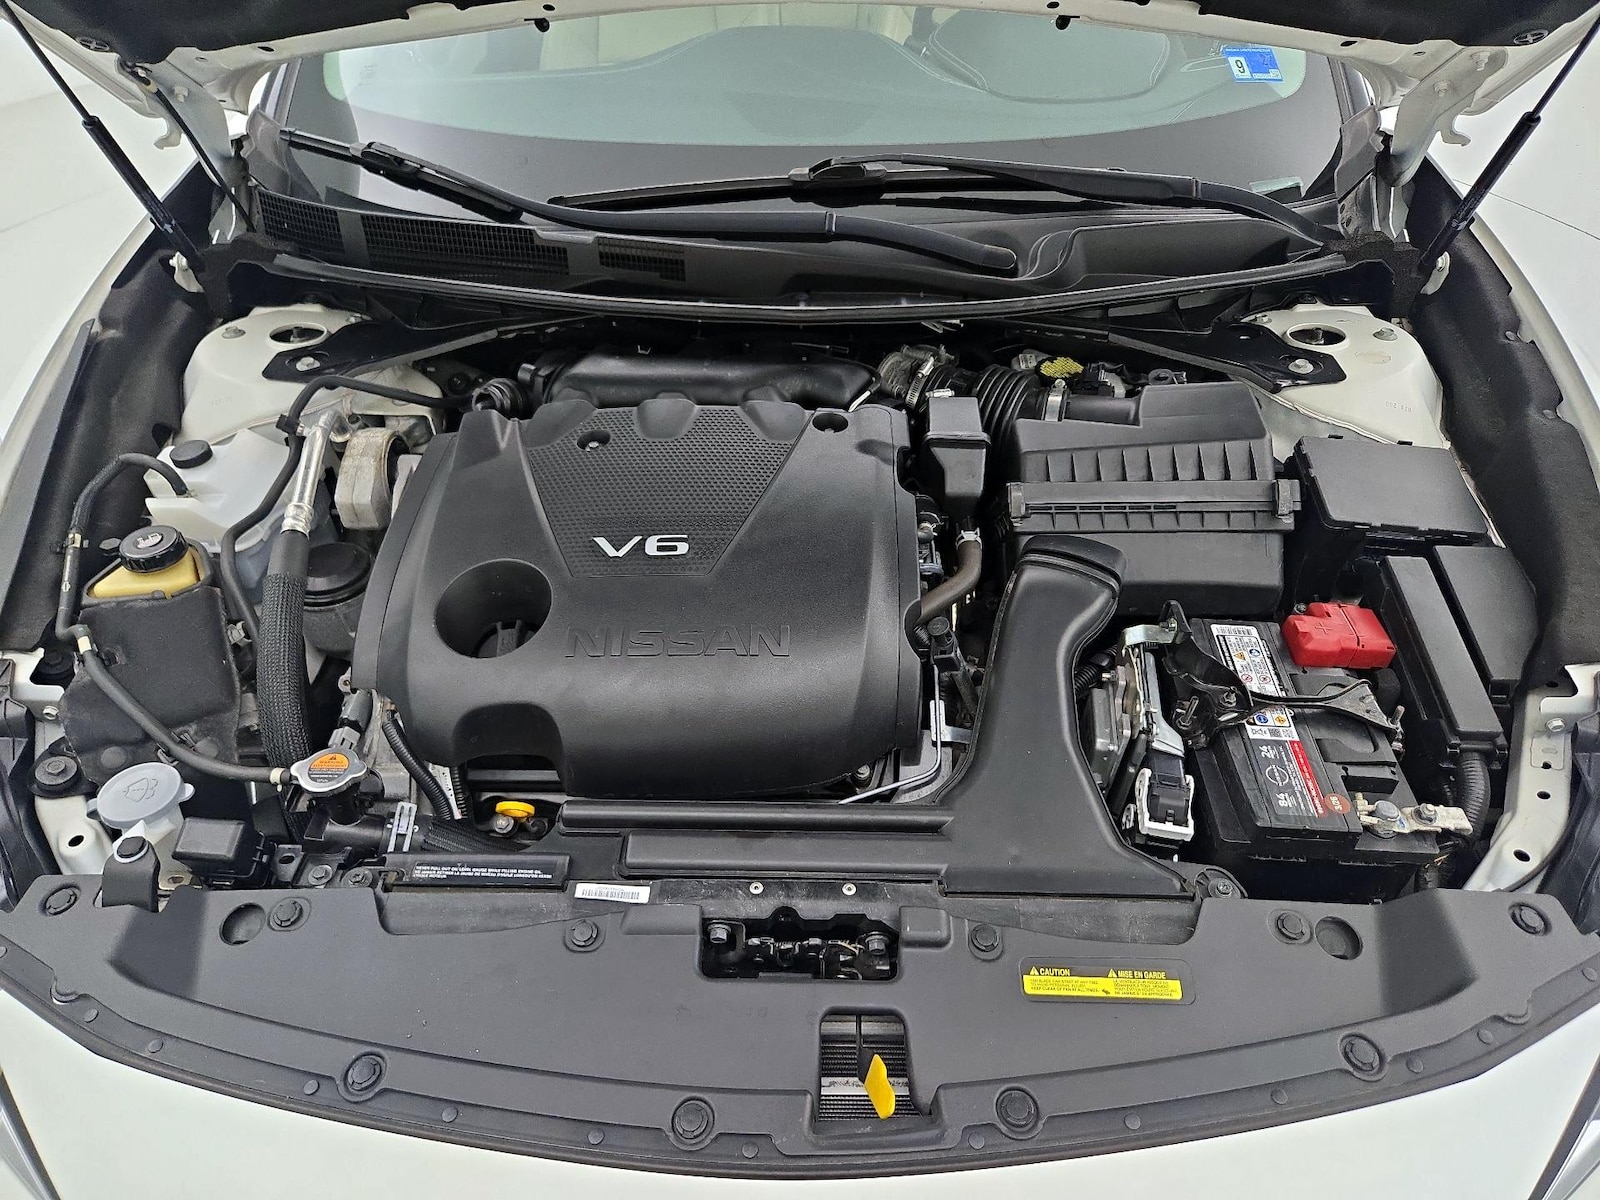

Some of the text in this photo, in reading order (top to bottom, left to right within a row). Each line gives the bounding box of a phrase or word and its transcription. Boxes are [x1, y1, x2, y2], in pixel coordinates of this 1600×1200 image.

[1235, 59, 1246, 74] 9
[592, 534, 690, 558] V6
[565, 624, 791, 657] NISSAN
[1039, 967, 1071, 977] CAUTION
[1117, 970, 1167, 980] MISE EN GARDE
